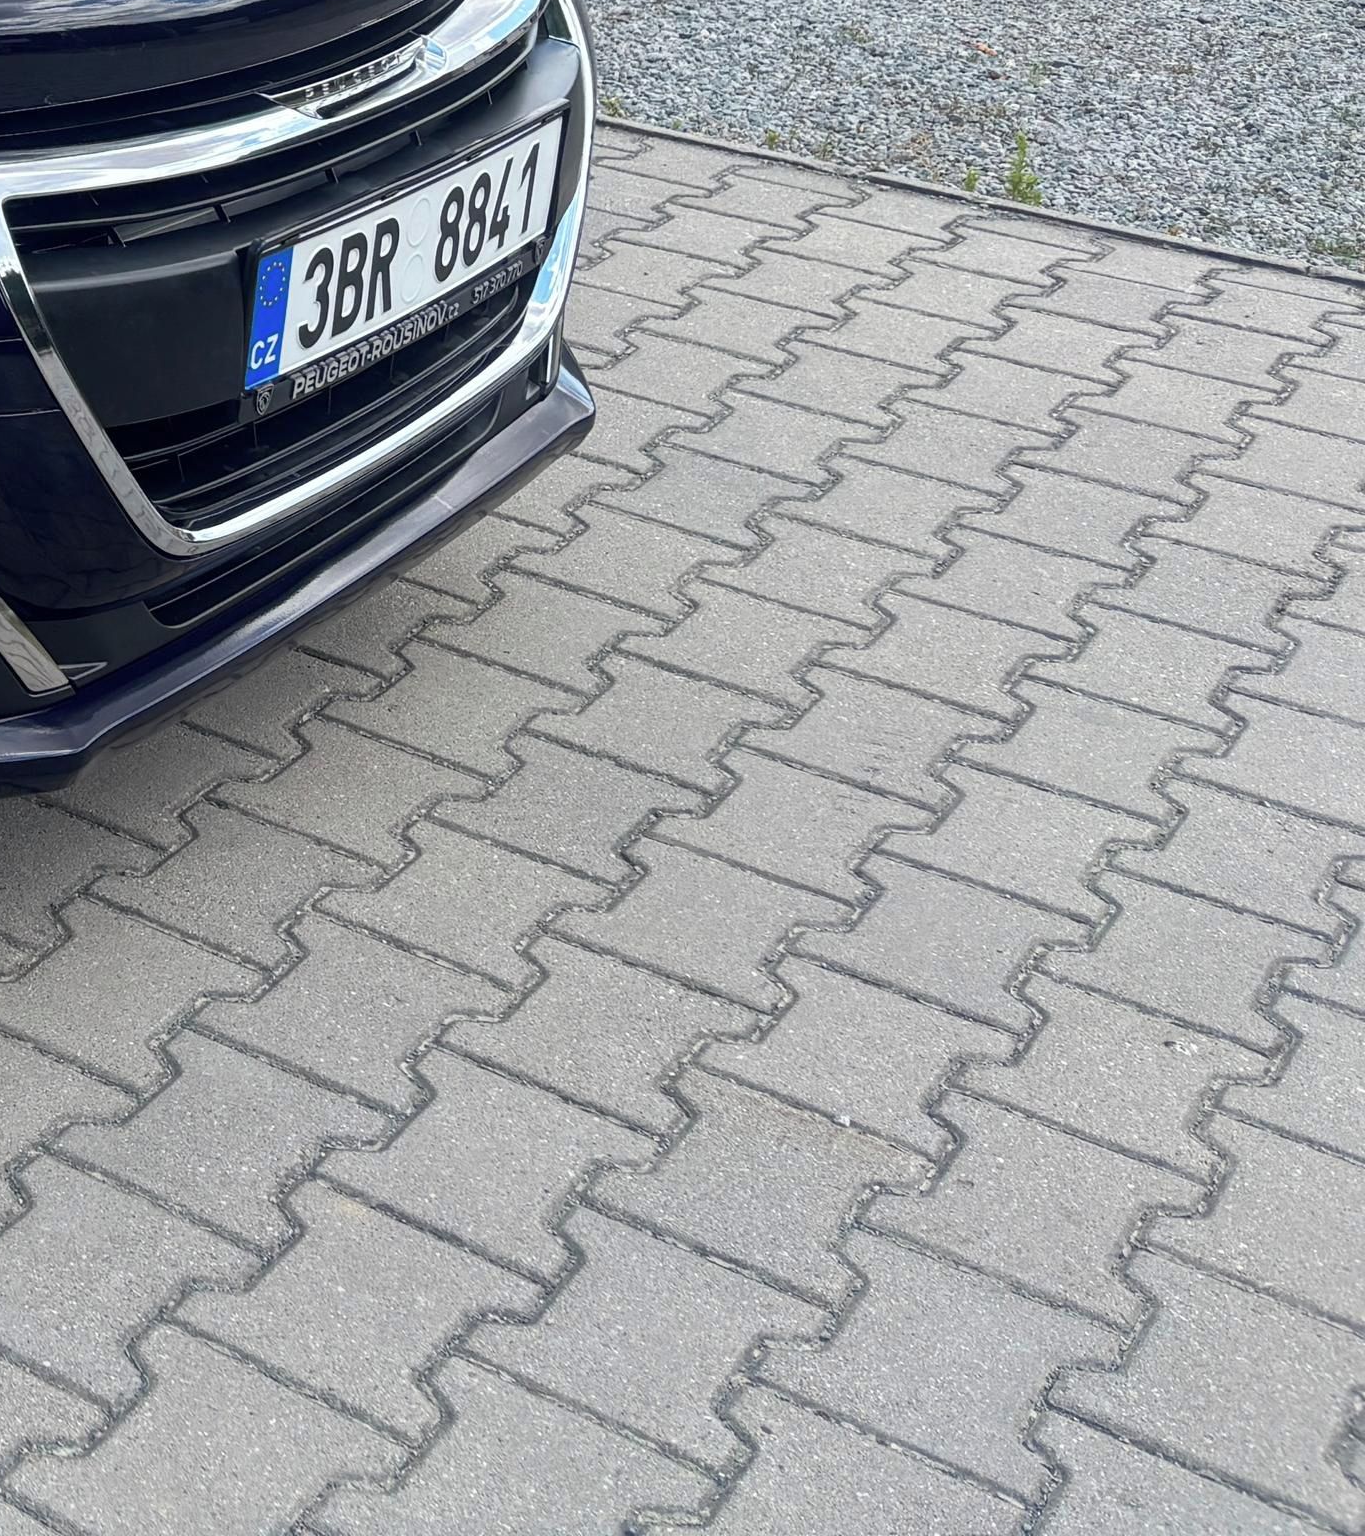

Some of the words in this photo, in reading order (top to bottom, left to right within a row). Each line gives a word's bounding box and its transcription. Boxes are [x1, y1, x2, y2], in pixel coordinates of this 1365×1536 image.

[298, 217, 400, 349] 3BR
[434, 142, 540, 283] 8841
[250, 334, 279, 370] CZ
[289, 300, 460, 400] PEUGEOT-ROUSINOV.cz
